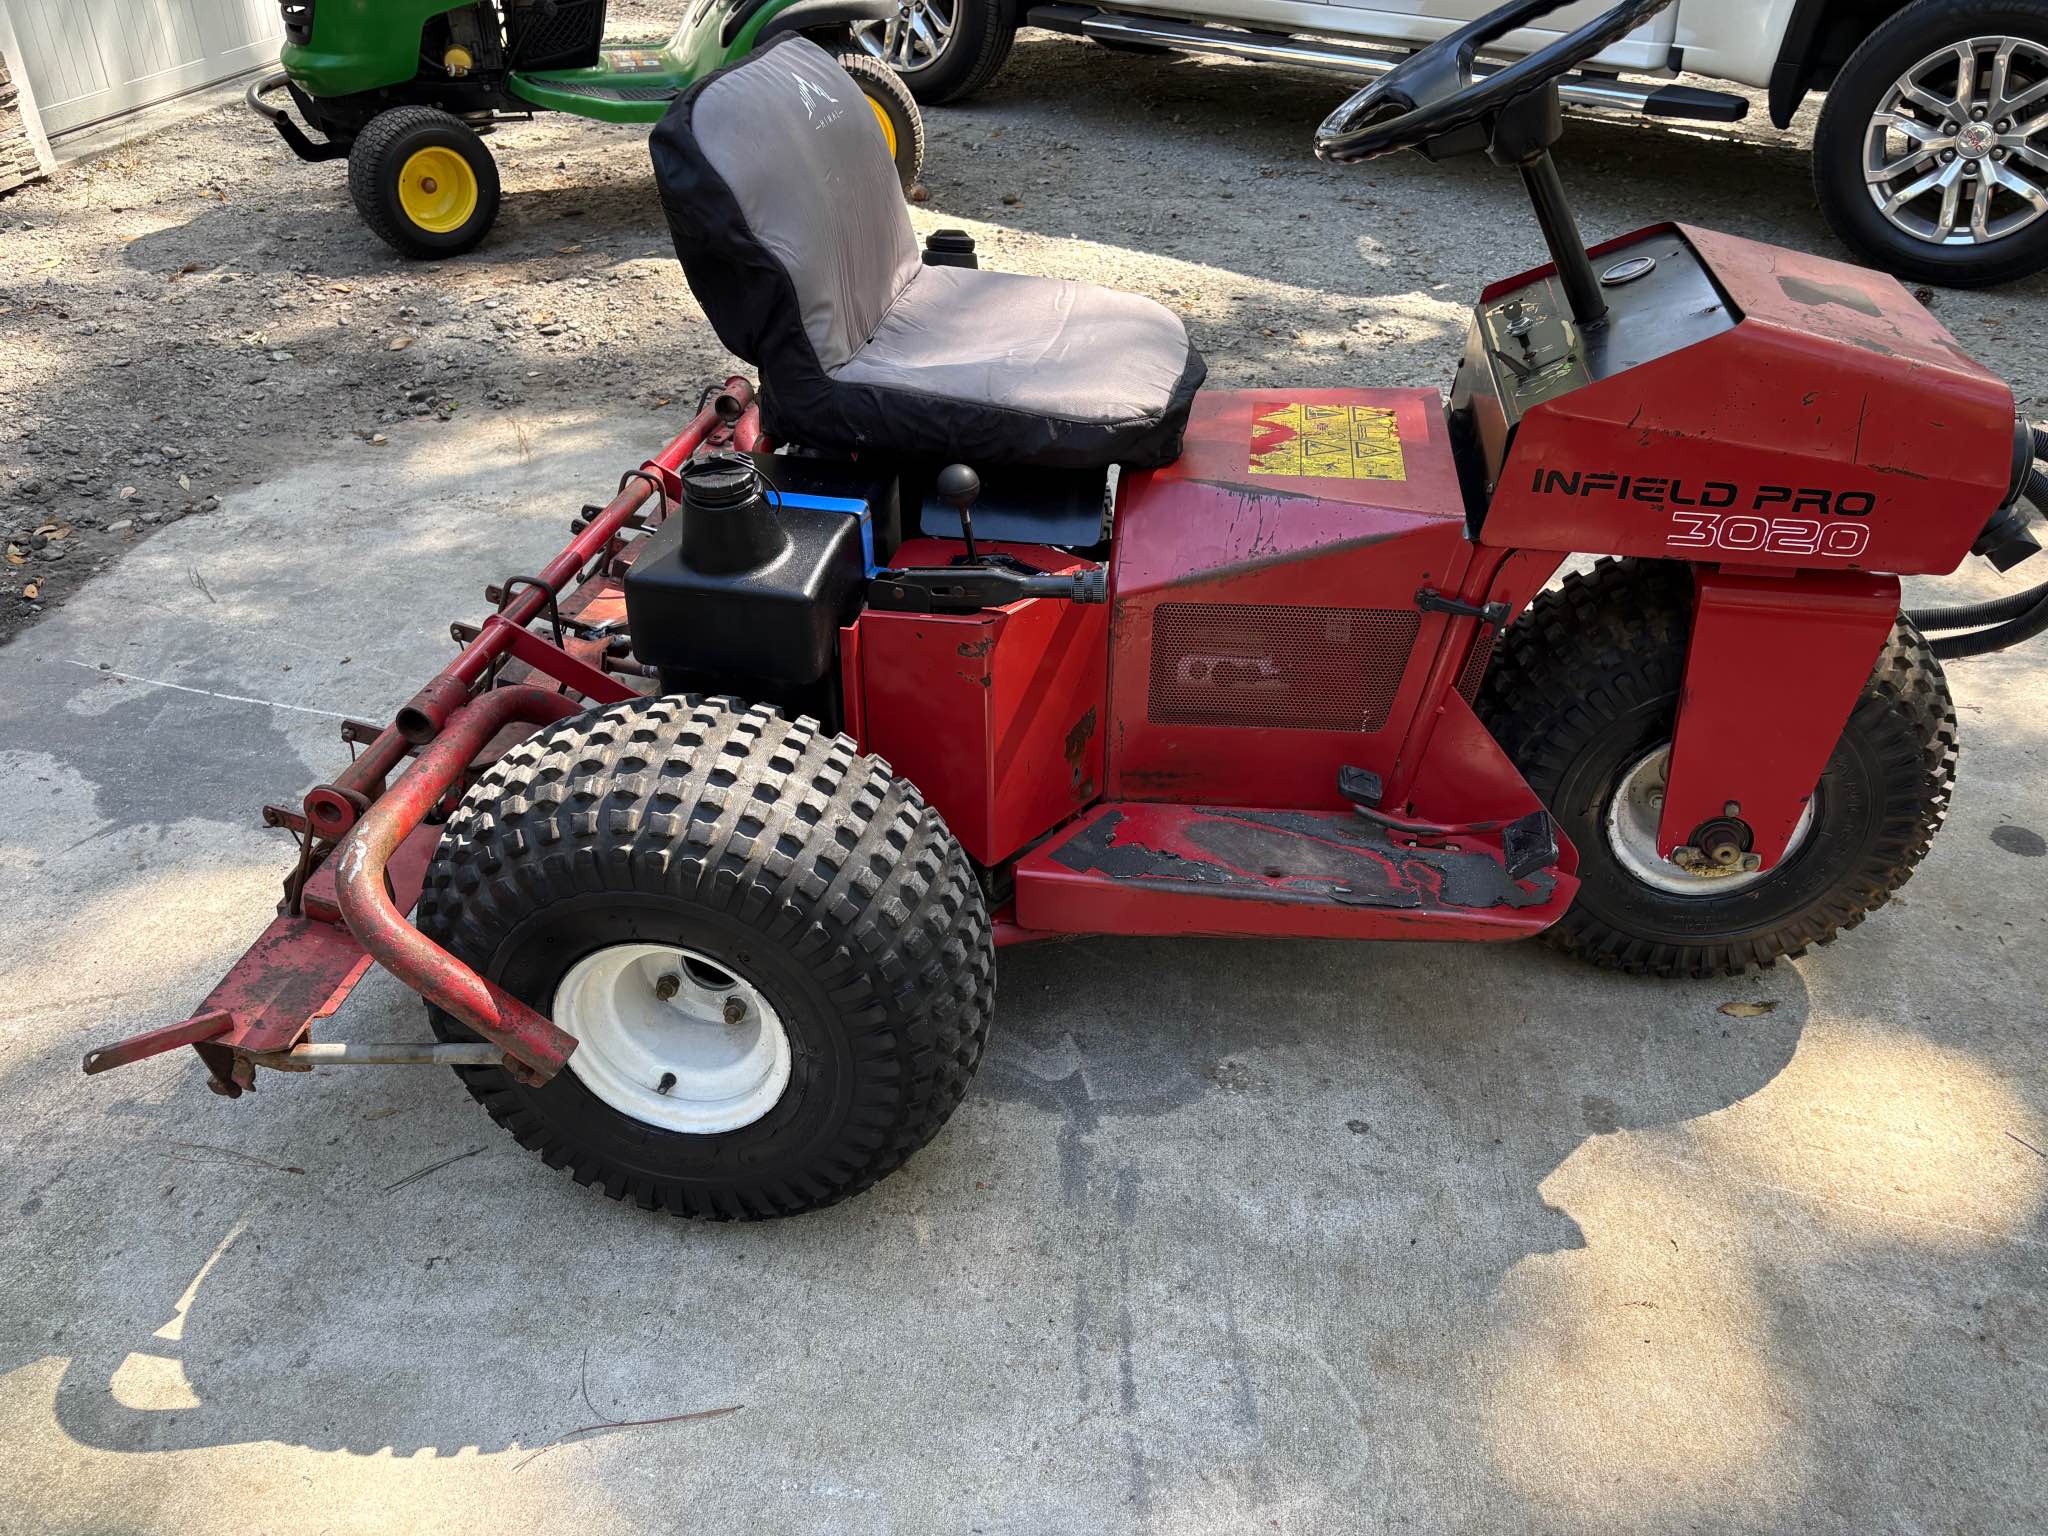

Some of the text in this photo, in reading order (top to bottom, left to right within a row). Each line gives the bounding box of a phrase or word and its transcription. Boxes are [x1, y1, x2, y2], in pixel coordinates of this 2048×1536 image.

[1967, 130, 1984, 152] GMC
[1531, 468, 1876, 516] INFIELD PRO
[1666, 512, 1870, 557] 3020
